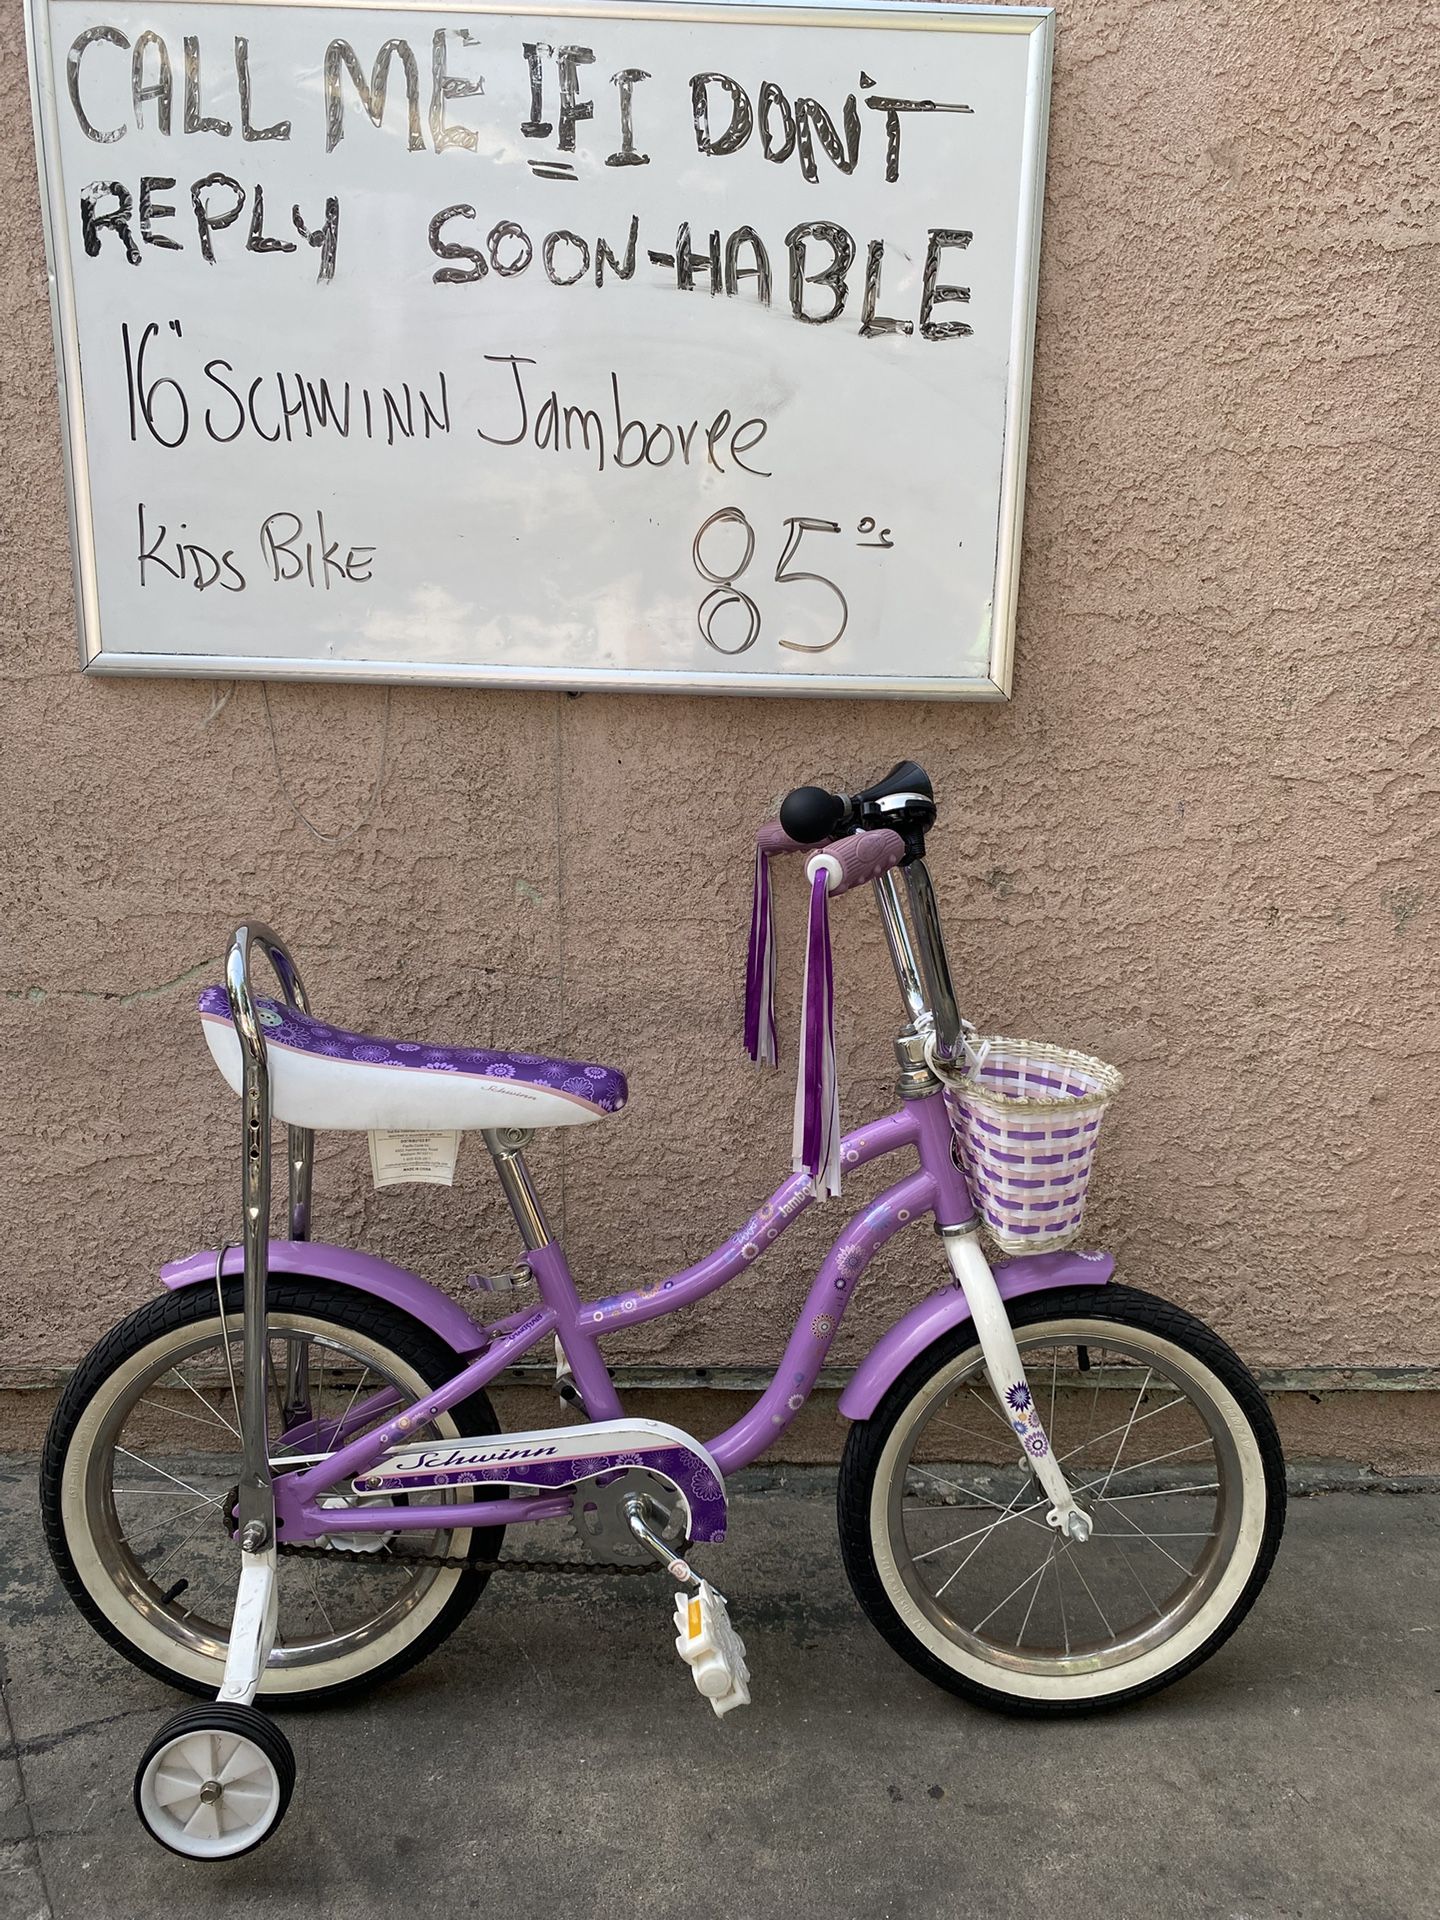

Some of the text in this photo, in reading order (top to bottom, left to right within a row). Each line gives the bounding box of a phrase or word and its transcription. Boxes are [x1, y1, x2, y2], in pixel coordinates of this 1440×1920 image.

[66, 25, 976, 185] CALL ME IF I DON'T
[80, 171, 340, 285] REPLY
[203, 359, 451, 447] SCHWINN
[476, 354, 773, 478] Jamboree
[481, 1085, 537, 1101] Schwinn
[396, 1446, 559, 1471] Schwinn
